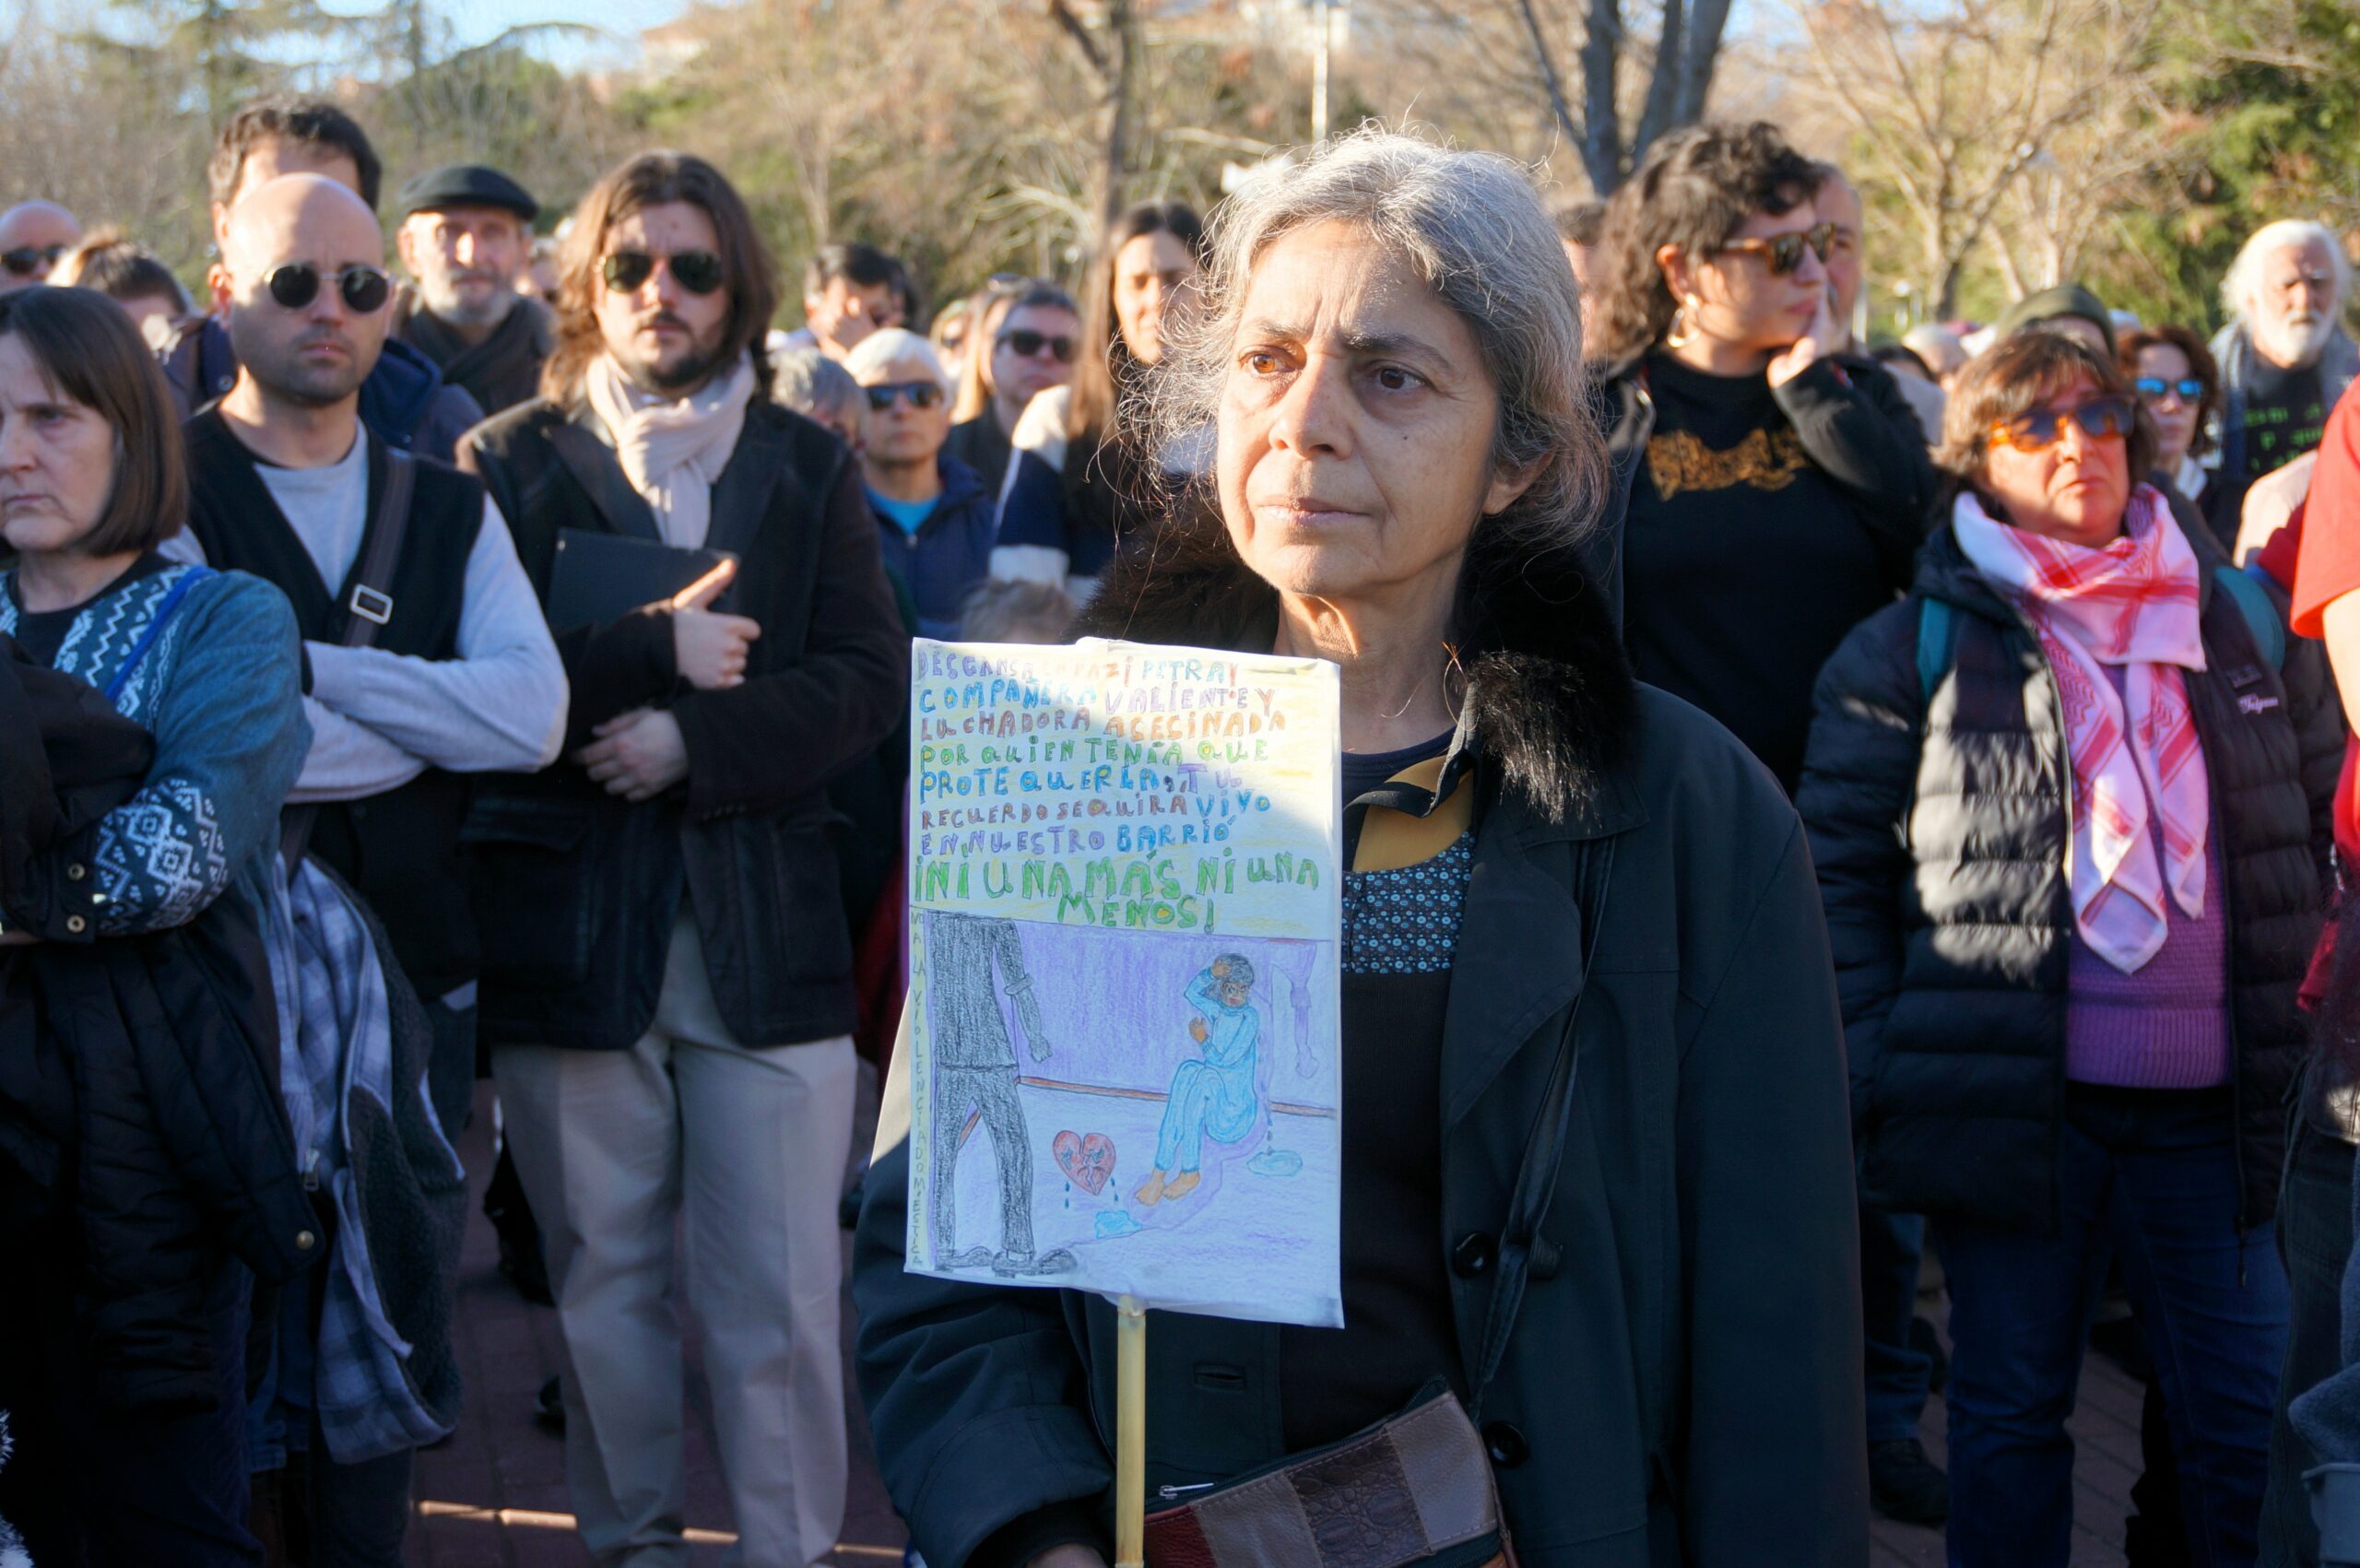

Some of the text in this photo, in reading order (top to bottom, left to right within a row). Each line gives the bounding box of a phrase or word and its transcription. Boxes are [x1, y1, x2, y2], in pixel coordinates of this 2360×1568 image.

[919, 678, 1097, 713] COMPAÑERA
[1256, 687, 1276, 716] Y
[921, 707, 1092, 741] LUCHADORA
[920, 743, 970, 775] POR
[1197, 739, 1269, 764] QUE
[921, 802, 1049, 831] RECUERDO
[922, 831, 959, 855] EN
[968, 825, 1105, 855] NUESTRO
[1247, 851, 1319, 891] UNA
